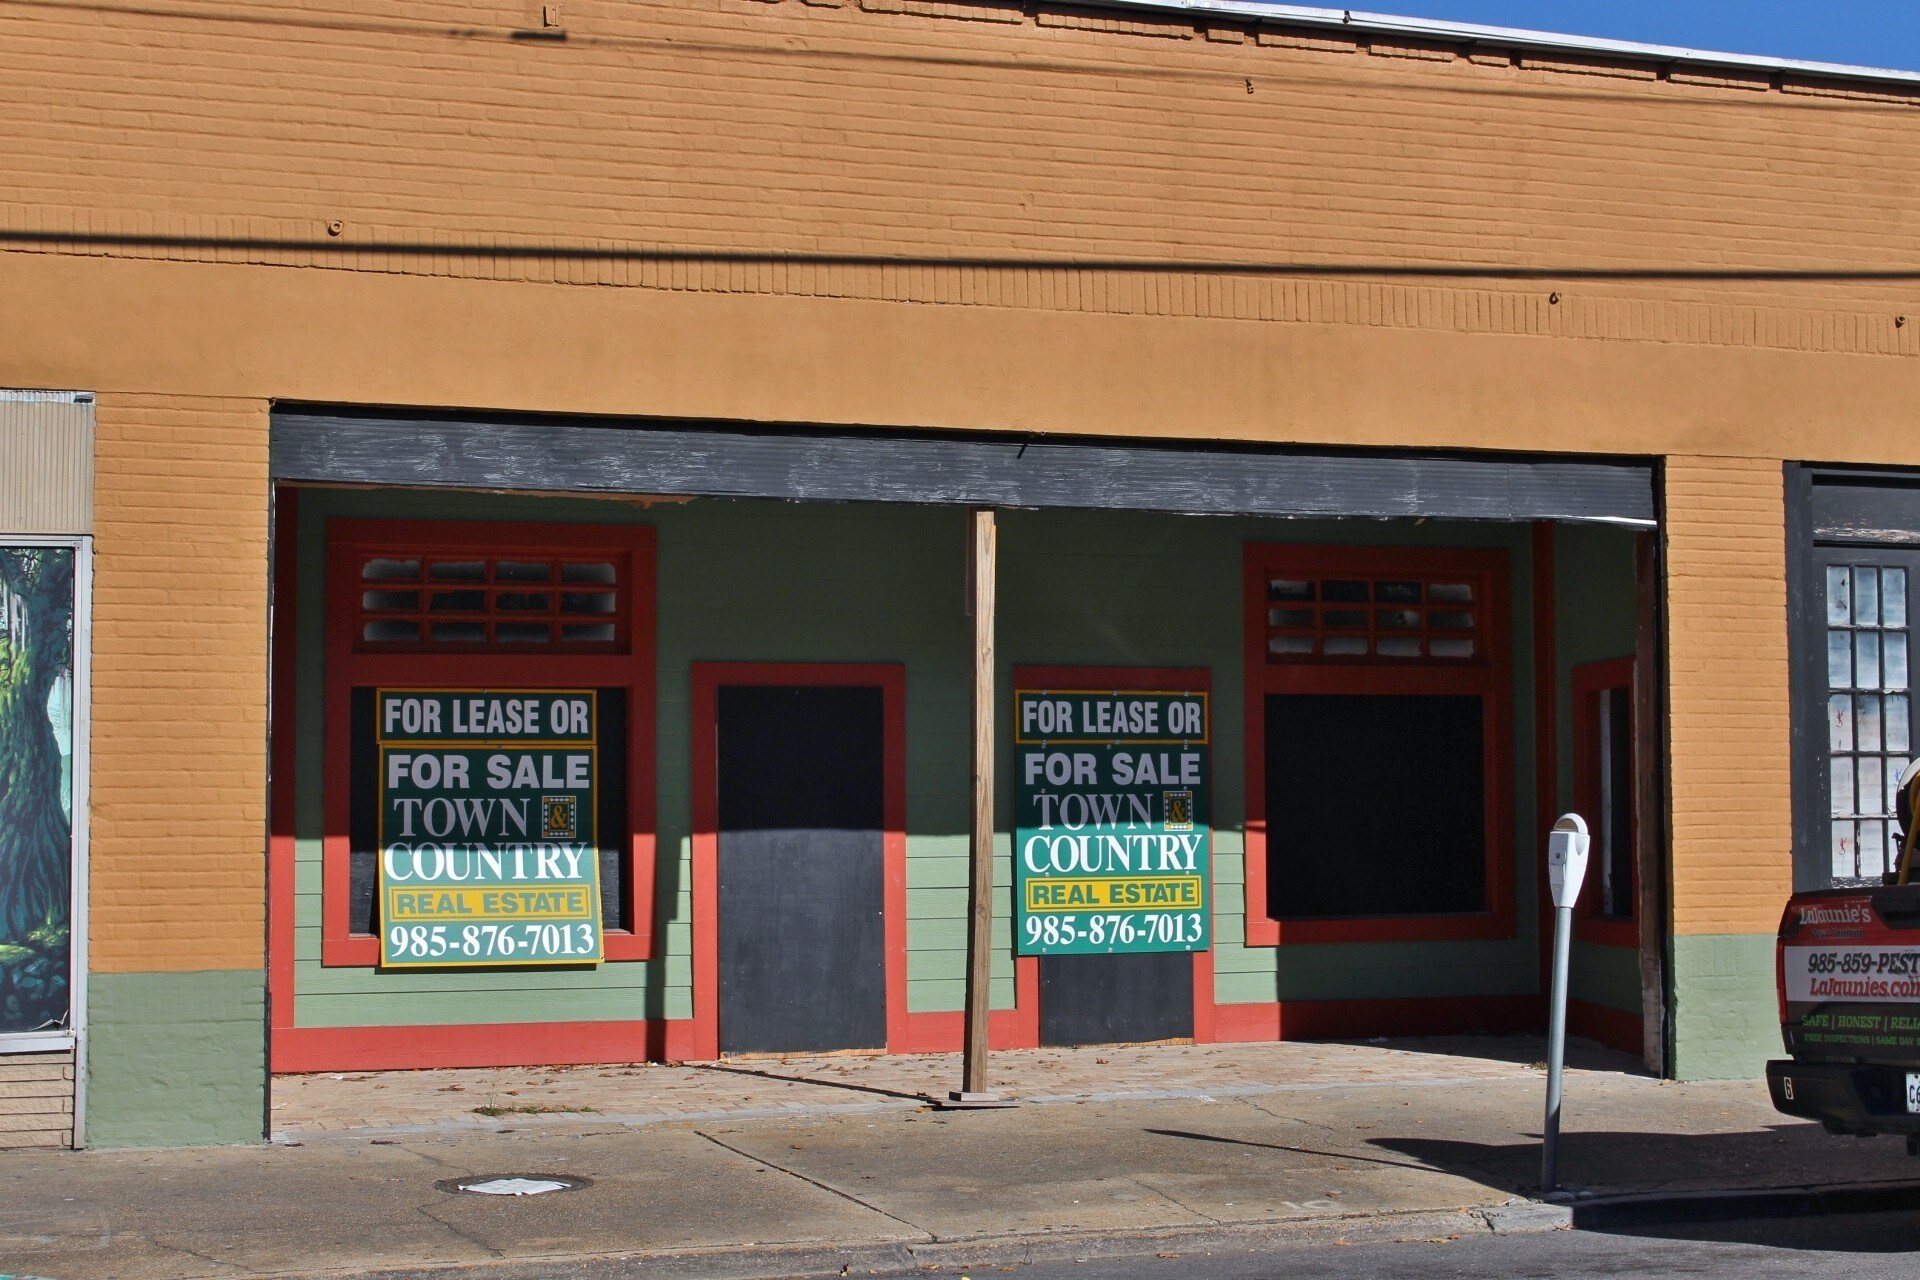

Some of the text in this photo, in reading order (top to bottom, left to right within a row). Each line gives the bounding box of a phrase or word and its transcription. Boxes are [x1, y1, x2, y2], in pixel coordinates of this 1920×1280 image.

[385, 699, 589, 734] FOR LEASE OR
[1022, 700, 1201, 734] FOR LEASE OR
[388, 754, 590, 789] FOR SALE
[1025, 752, 1201, 785] FOR SALE
[393, 797, 567, 837] TOWN &
[1033, 793, 1186, 831] TOWN &
[384, 841, 588, 881] COUNTRY
[1024, 834, 1203, 873] COUNTRY
[397, 892, 584, 915] REAL ESTATE
[1032, 882, 1195, 905] REAL ESTATE
[390, 923, 595, 957] 985-876-7013
[1026, 913, 1202, 945] 985-876-7013
[1807, 952, 1920, 974] 985-859-PEST
[1801, 1014, 1829, 1027] SAFE
[1838, 1015, 1881, 1029] HONEST
[1804, 1033, 1823, 1042] FREE
[1824, 1034, 1870, 1044] INSPECTIONS
[1876, 1036, 1897, 1045] SAME
[1900, 1037, 1914, 1046] DAY
